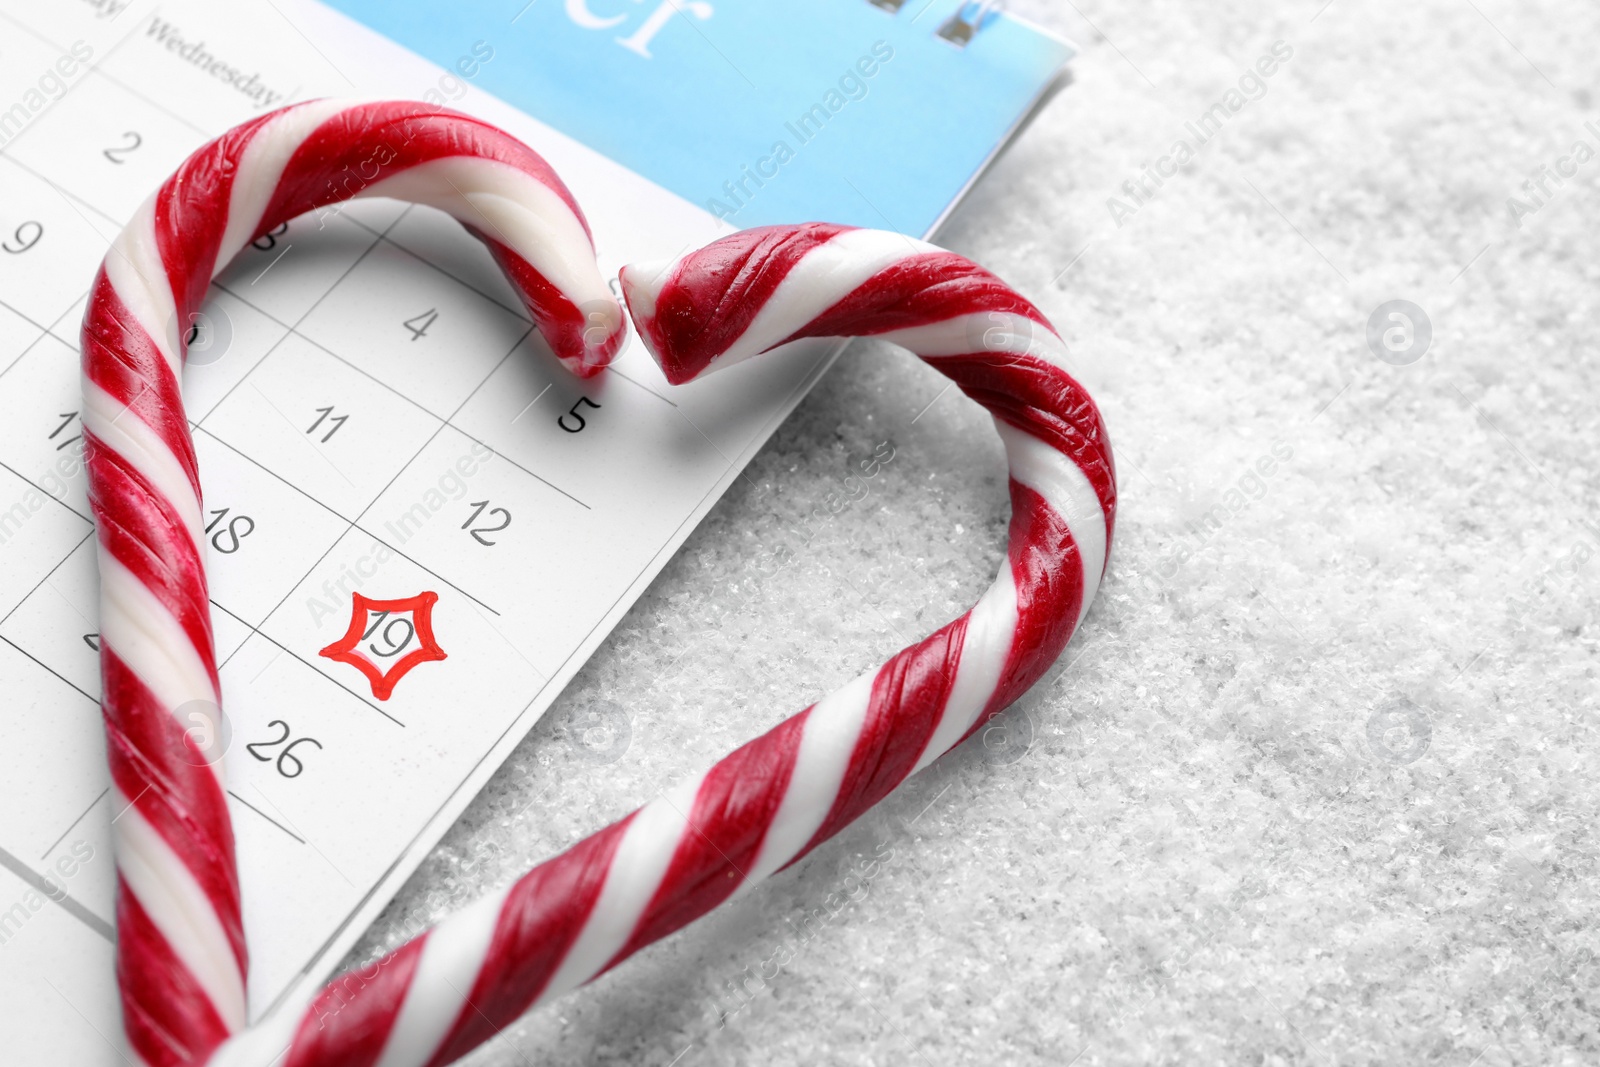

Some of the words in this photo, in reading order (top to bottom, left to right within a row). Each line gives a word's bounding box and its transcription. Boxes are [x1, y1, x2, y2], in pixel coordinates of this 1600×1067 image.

[147, 17, 285, 109] Wednesday
[102, 131, 142, 164] 2
[2, 221, 43, 254] 9
[403, 308, 438, 341] 4
[306, 405, 349, 443] 11
[557, 396, 601, 433] 5
[204, 507, 255, 554] 18
[461, 500, 512, 546] 12
[361, 610, 414, 657] 19
[246, 720, 323, 778] 26
